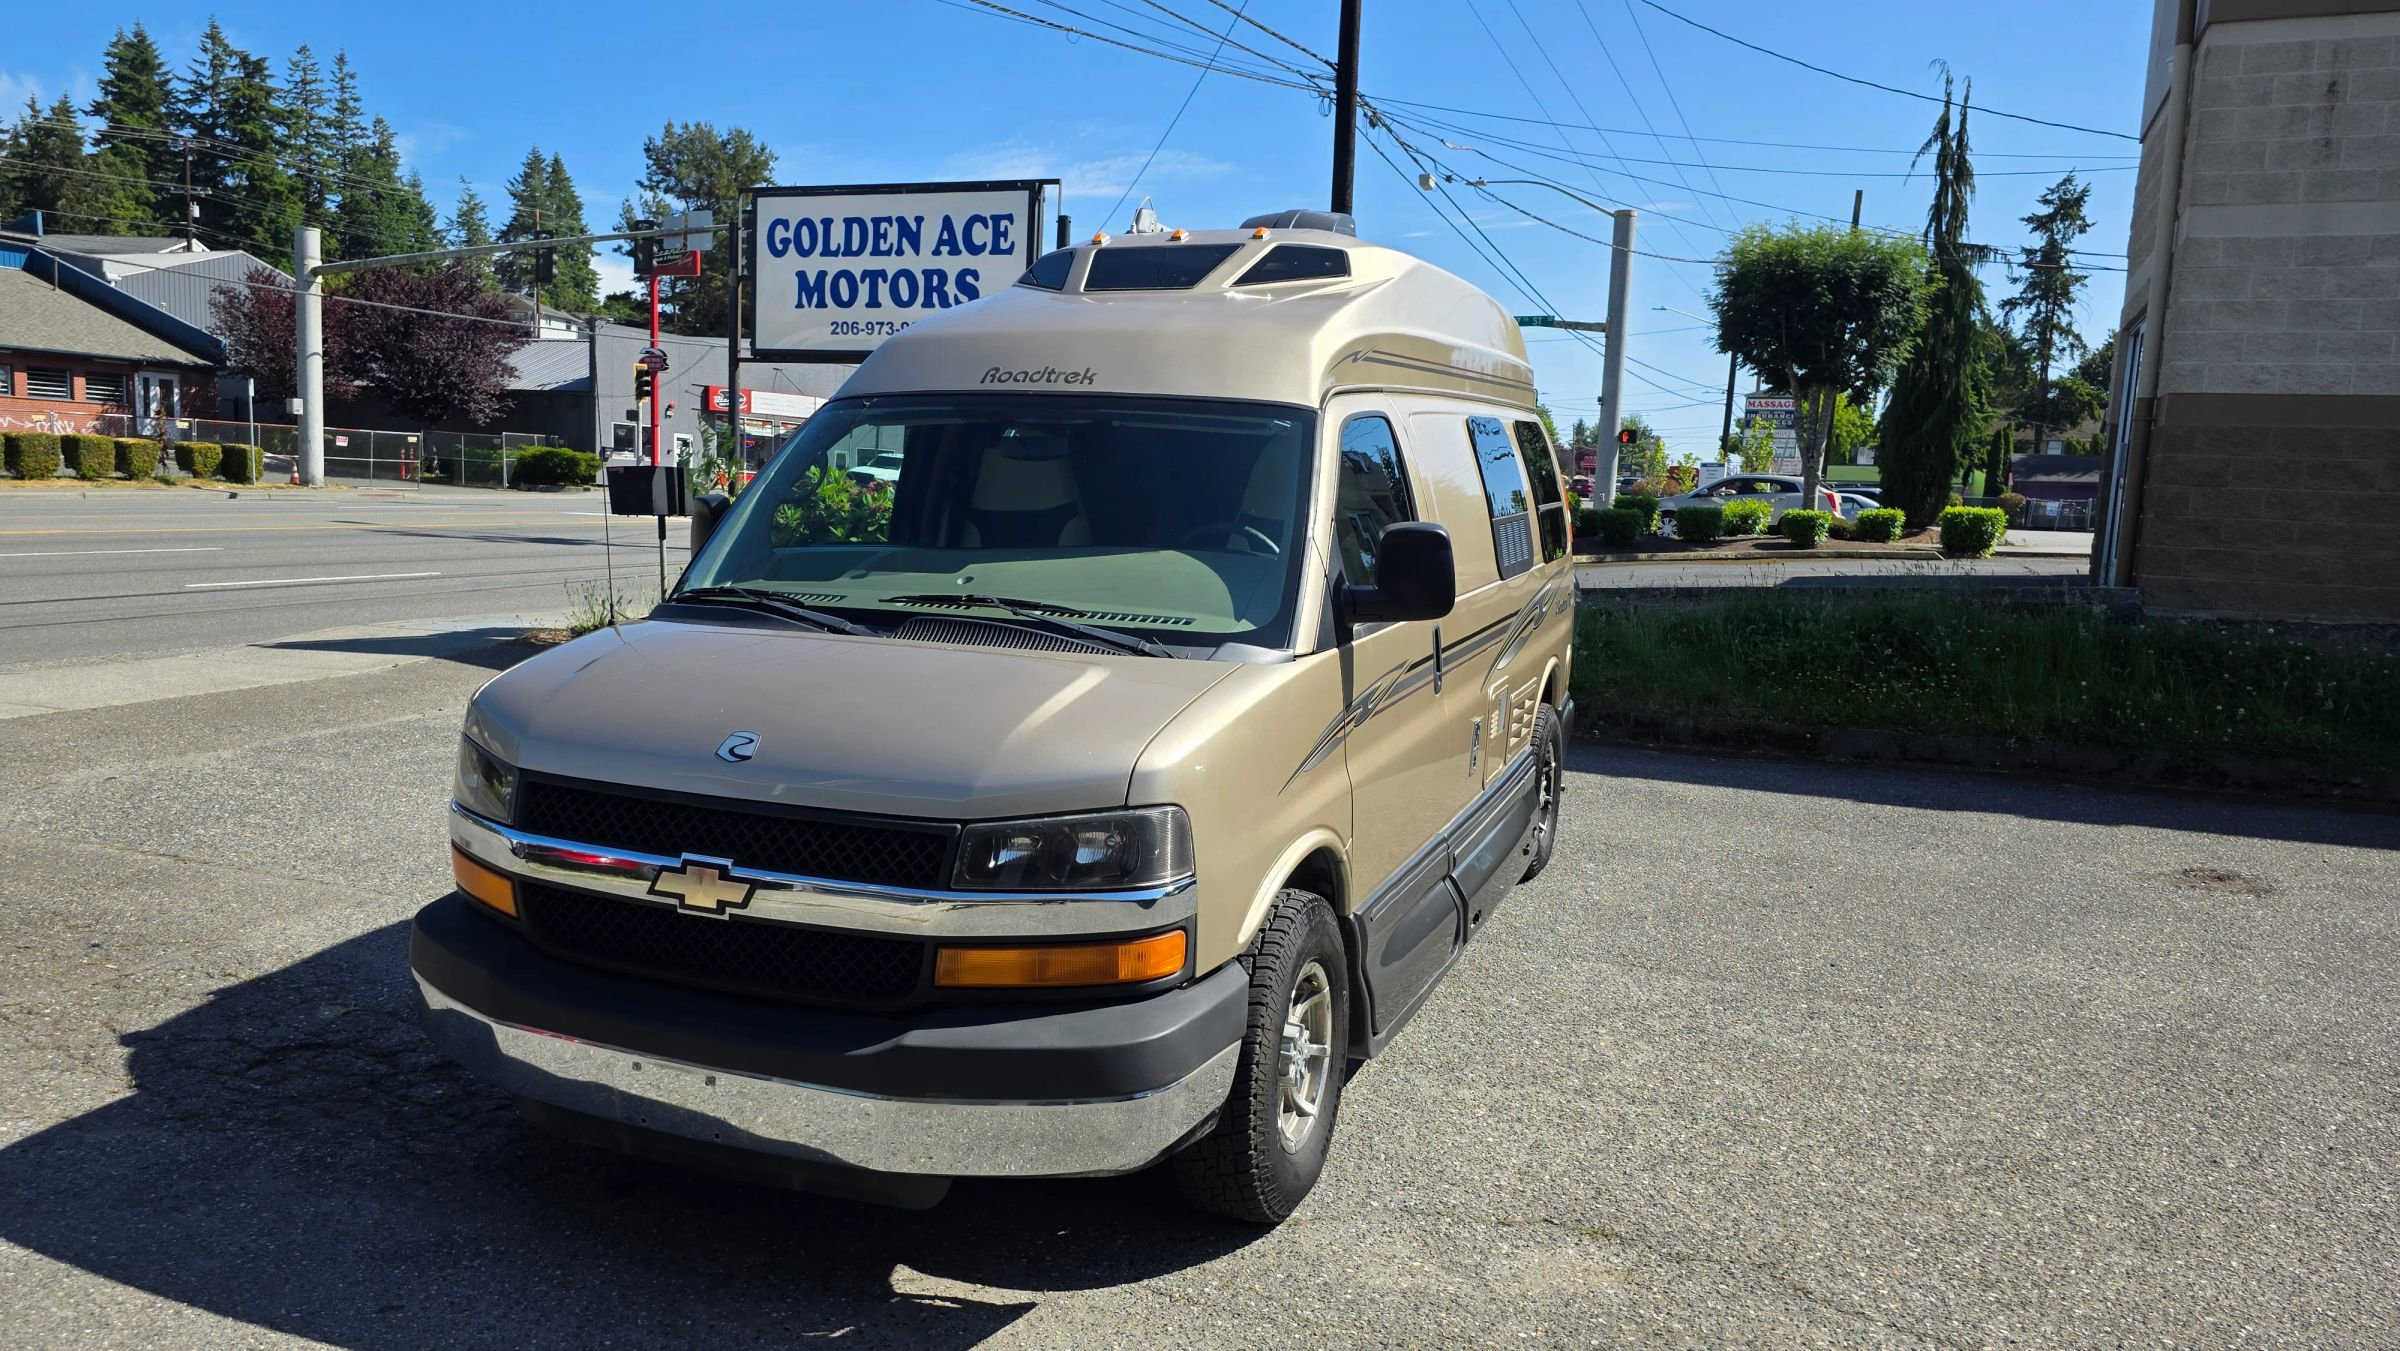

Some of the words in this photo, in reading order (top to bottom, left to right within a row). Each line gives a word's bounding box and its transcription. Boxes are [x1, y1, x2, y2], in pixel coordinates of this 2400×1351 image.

[766, 215, 925, 258] GOLDEN
[931, 213, 1016, 256] ACE
[794, 267, 981, 309] MOTORS
[829, 320, 916, 336] 206-973-
[980, 366, 1099, 385] Roadtrek
